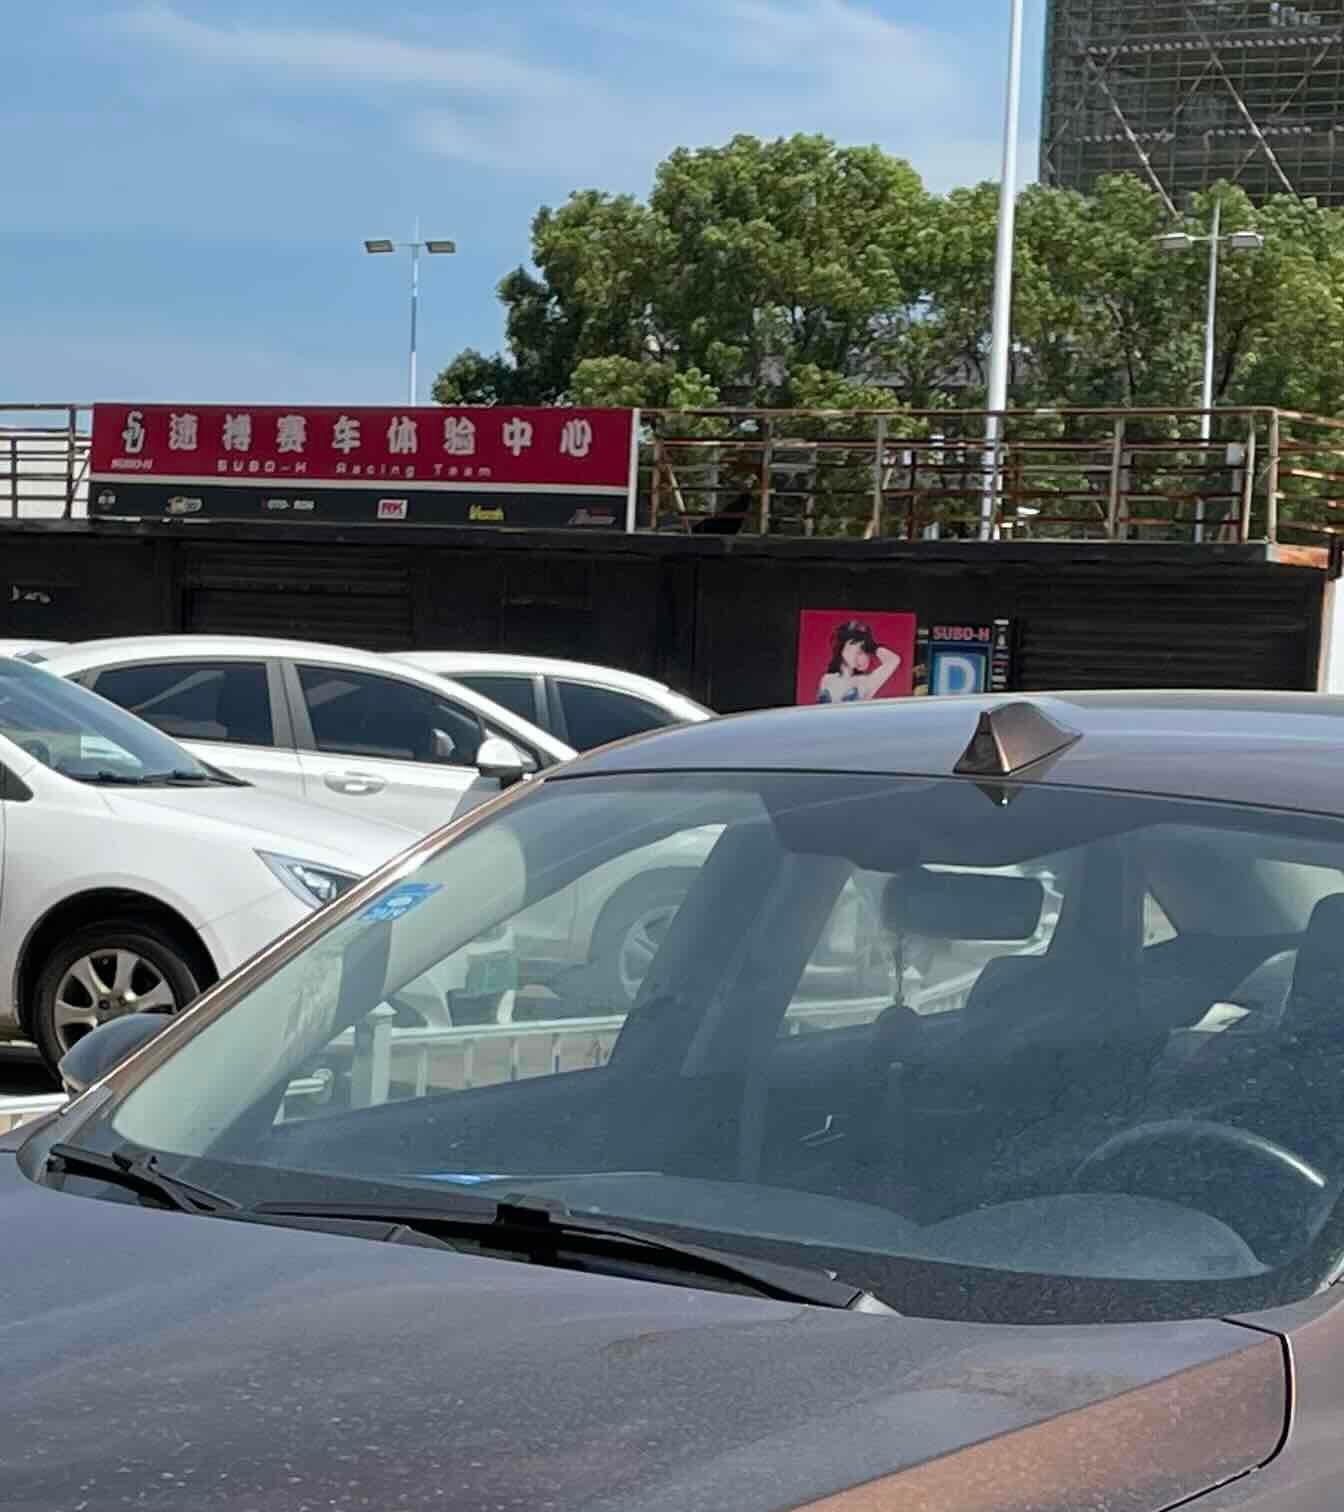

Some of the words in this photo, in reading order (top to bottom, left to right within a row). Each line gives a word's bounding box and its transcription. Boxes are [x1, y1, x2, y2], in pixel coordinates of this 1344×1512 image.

[217, 460, 307, 473] SUBO-H
[336, 462, 415, 478] Racing
[433, 463, 492, 477] Team
[933, 627, 990, 640] SUBO-H
